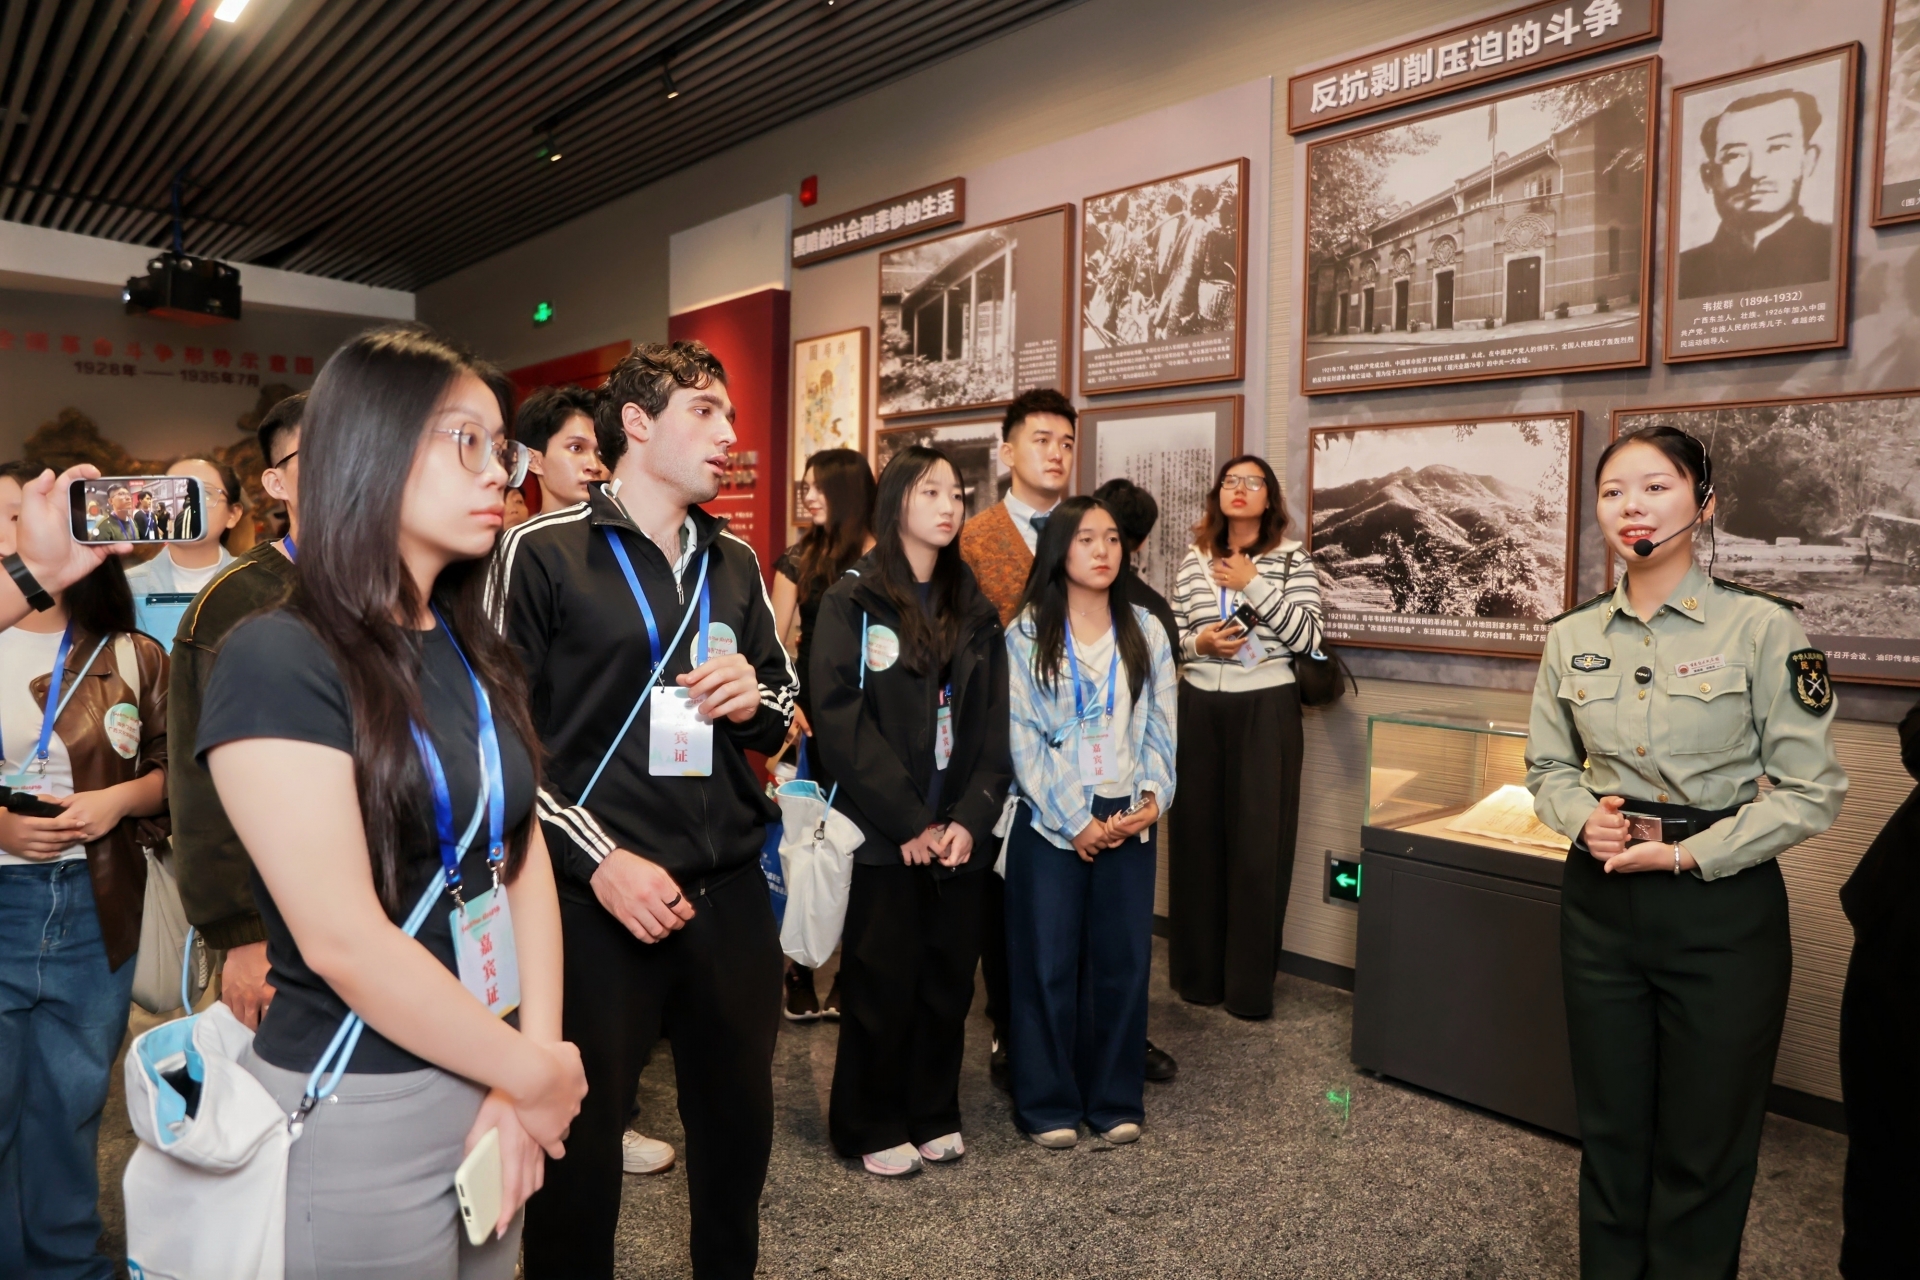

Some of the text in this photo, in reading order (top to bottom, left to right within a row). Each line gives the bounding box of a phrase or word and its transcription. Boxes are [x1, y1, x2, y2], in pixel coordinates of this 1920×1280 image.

[1310, 0, 1622, 113] 反抗剥削压迫的斗争
[793, 189, 955, 258] 黑暗的社会和悲惨的生活
[1091, 743, 1104, 776] 嘉宾证
[479, 932, 500, 1007] 嘉宾证
